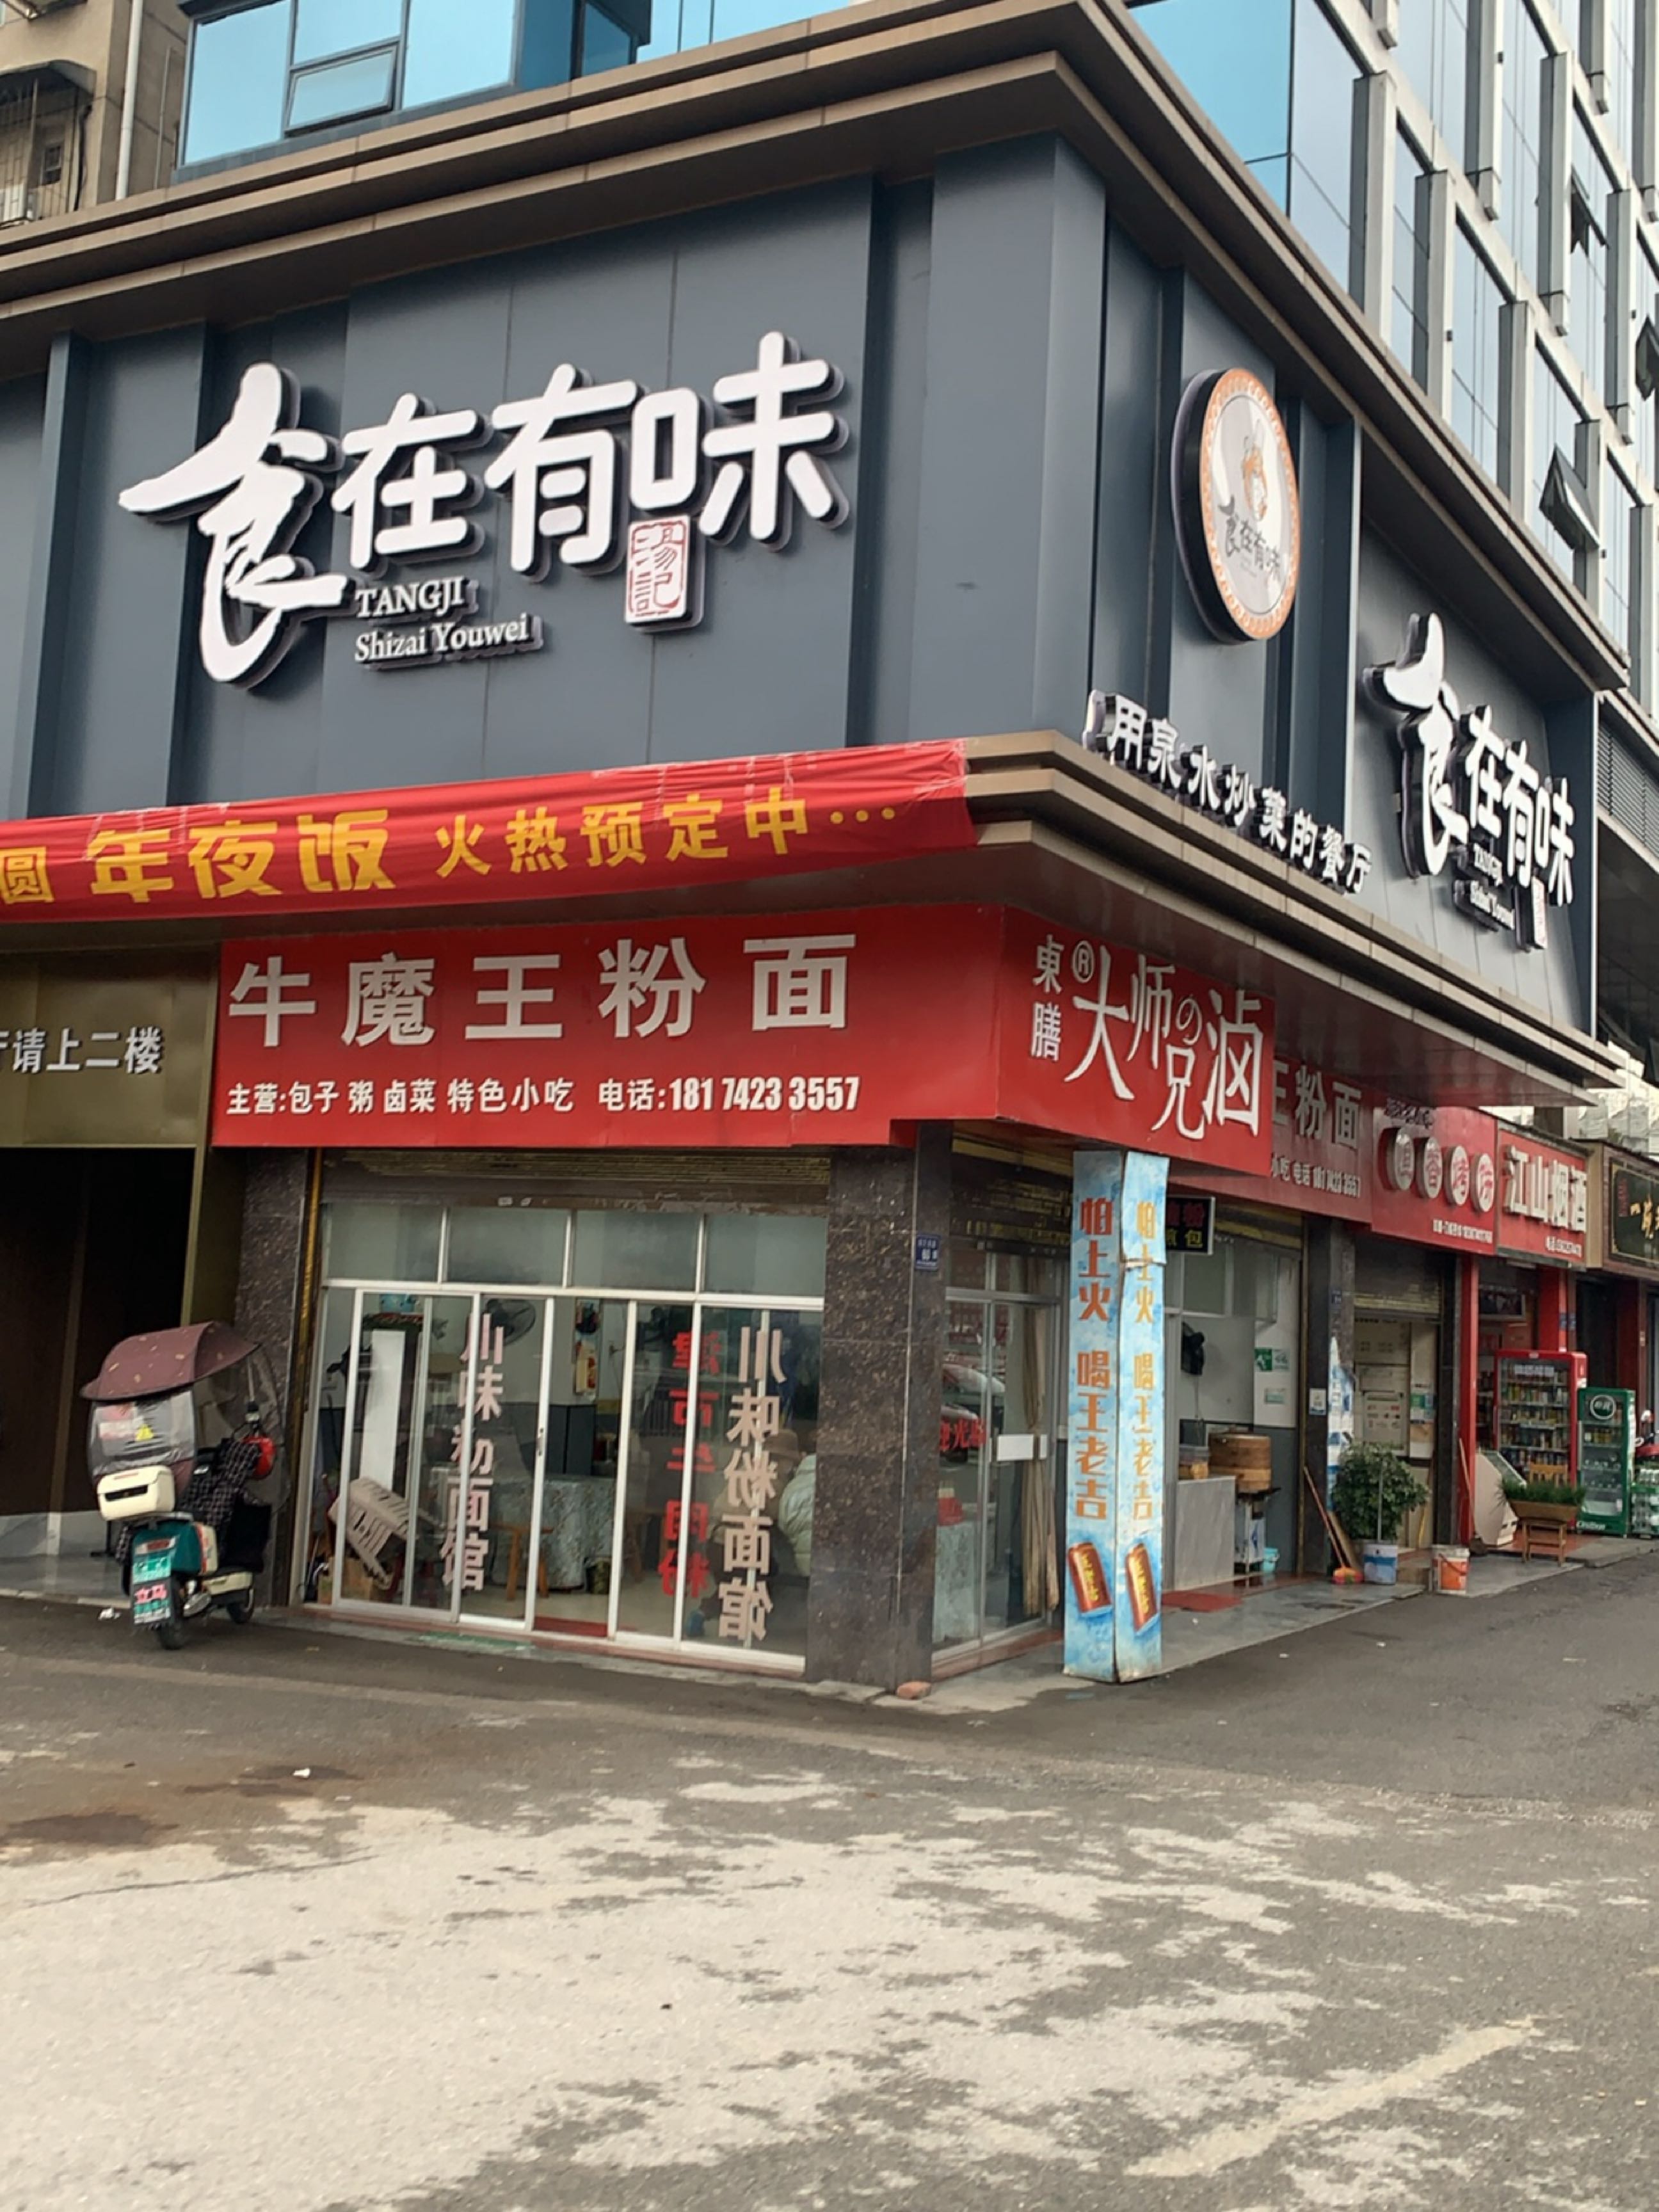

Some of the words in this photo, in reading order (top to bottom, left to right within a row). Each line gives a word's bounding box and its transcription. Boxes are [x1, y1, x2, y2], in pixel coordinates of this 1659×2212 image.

[118, 330, 833, 682] 食在有味
[355, 575, 465, 617] TANGJI
[355, 627, 426, 662] Shizai
[429, 612, 529, 653] Youwei
[1108, 694, 1372, 894] 用泉水炒菜的餐厅
[1383, 613, 1574, 906] 食在有味
[86, 810, 396, 903] 年夜饭
[229, 934, 856, 1047] 牛魔王粉面
[383, 1078, 437, 1113] 卤菜
[447, 1077, 574, 1113] 特色小吃
[721, 1077, 782, 1110] 7423
[788, 1077, 860, 1110] 3557
[1078, 1197, 1113, 1322] 怕上火
[1075, 1350, 1111, 1520] 喝王老吉
